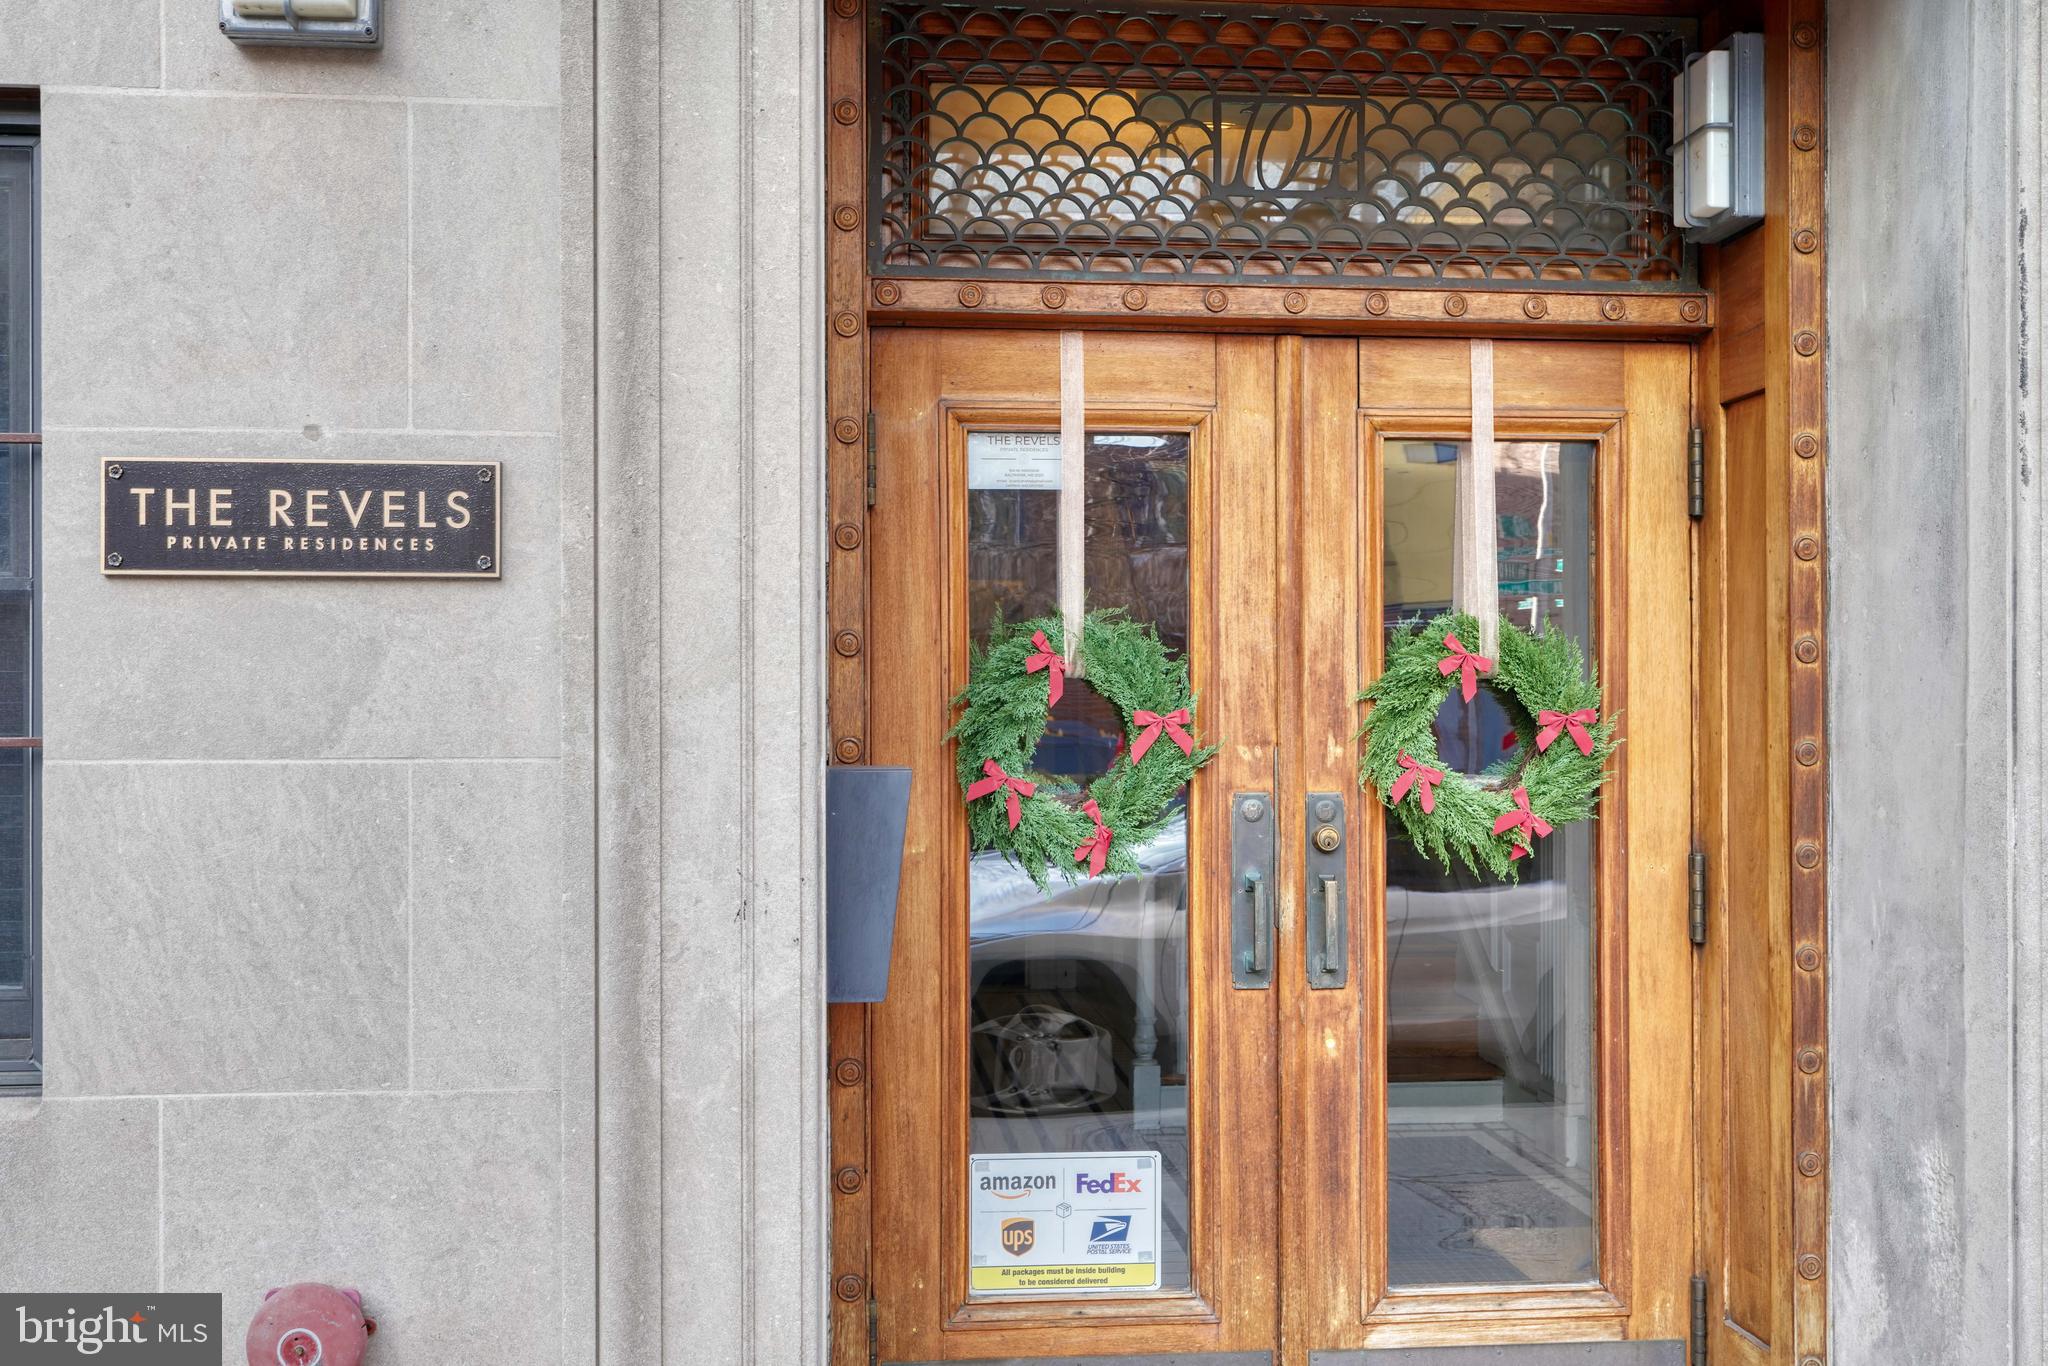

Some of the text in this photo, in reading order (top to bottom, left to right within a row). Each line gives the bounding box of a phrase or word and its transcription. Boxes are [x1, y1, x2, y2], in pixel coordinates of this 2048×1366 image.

[1230, 100, 1359, 192] 104
[988, 436, 1060, 446] THE REVELS
[130, 487, 472, 530] THE REVELS
[167, 536, 436, 552] PRIVATE RESIDENCES
[980, 1174, 1056, 1191] amazon
[1076, 1172, 1144, 1194] FedEx
[1004, 1229, 1033, 1252] ups
[1002, 1268, 1011, 1276] All
[1012, 1268, 1045, 1277] packages
[1065, 1267, 1074, 1275] be
[1075, 1267, 1097, 1275] inside
[1098, 1267, 1126, 1276] building
[1028, 1278, 1036, 1286] be
[1038, 1278, 1075, 1286] considered
[1077, 1277, 1108, 1285] delivered
